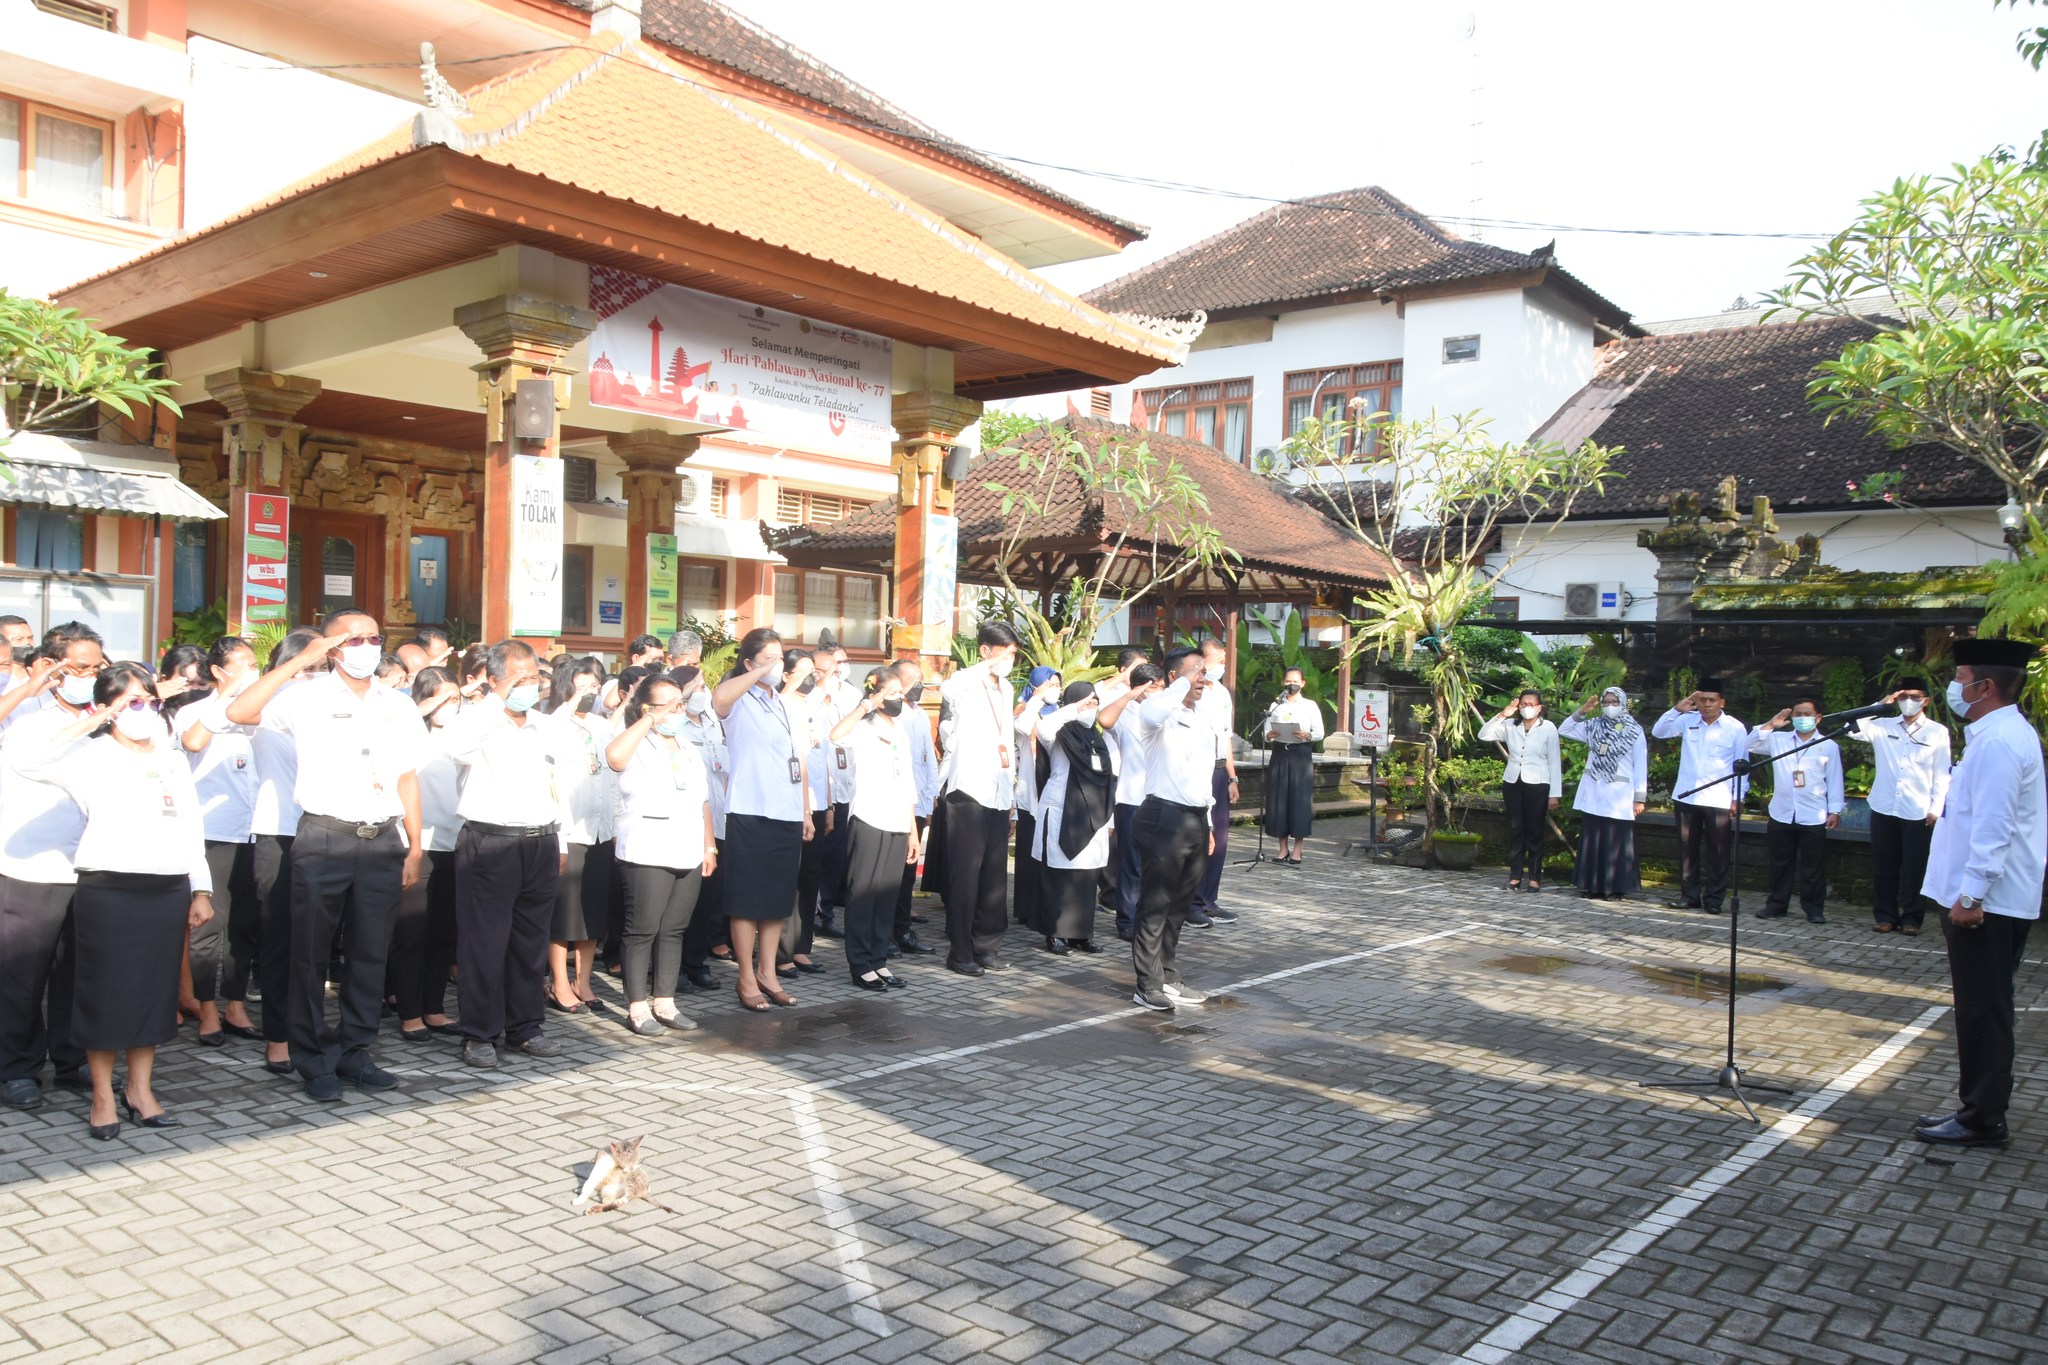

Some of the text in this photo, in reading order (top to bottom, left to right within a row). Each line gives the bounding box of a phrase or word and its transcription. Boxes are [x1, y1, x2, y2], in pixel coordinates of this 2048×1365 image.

[751, 336, 861, 370] Selamat Memperingati
[720, 348, 749, 366] Hari
[751, 355, 806, 379] Pahlawan
[808, 367, 854, 390] Nasional
[874, 384, 885, 397] 77
[525, 482, 554, 505] Kami
[520, 503, 557, 524] TOLAK
[259, 565, 275, 574] wbs
[660, 555, 667, 570] 5
